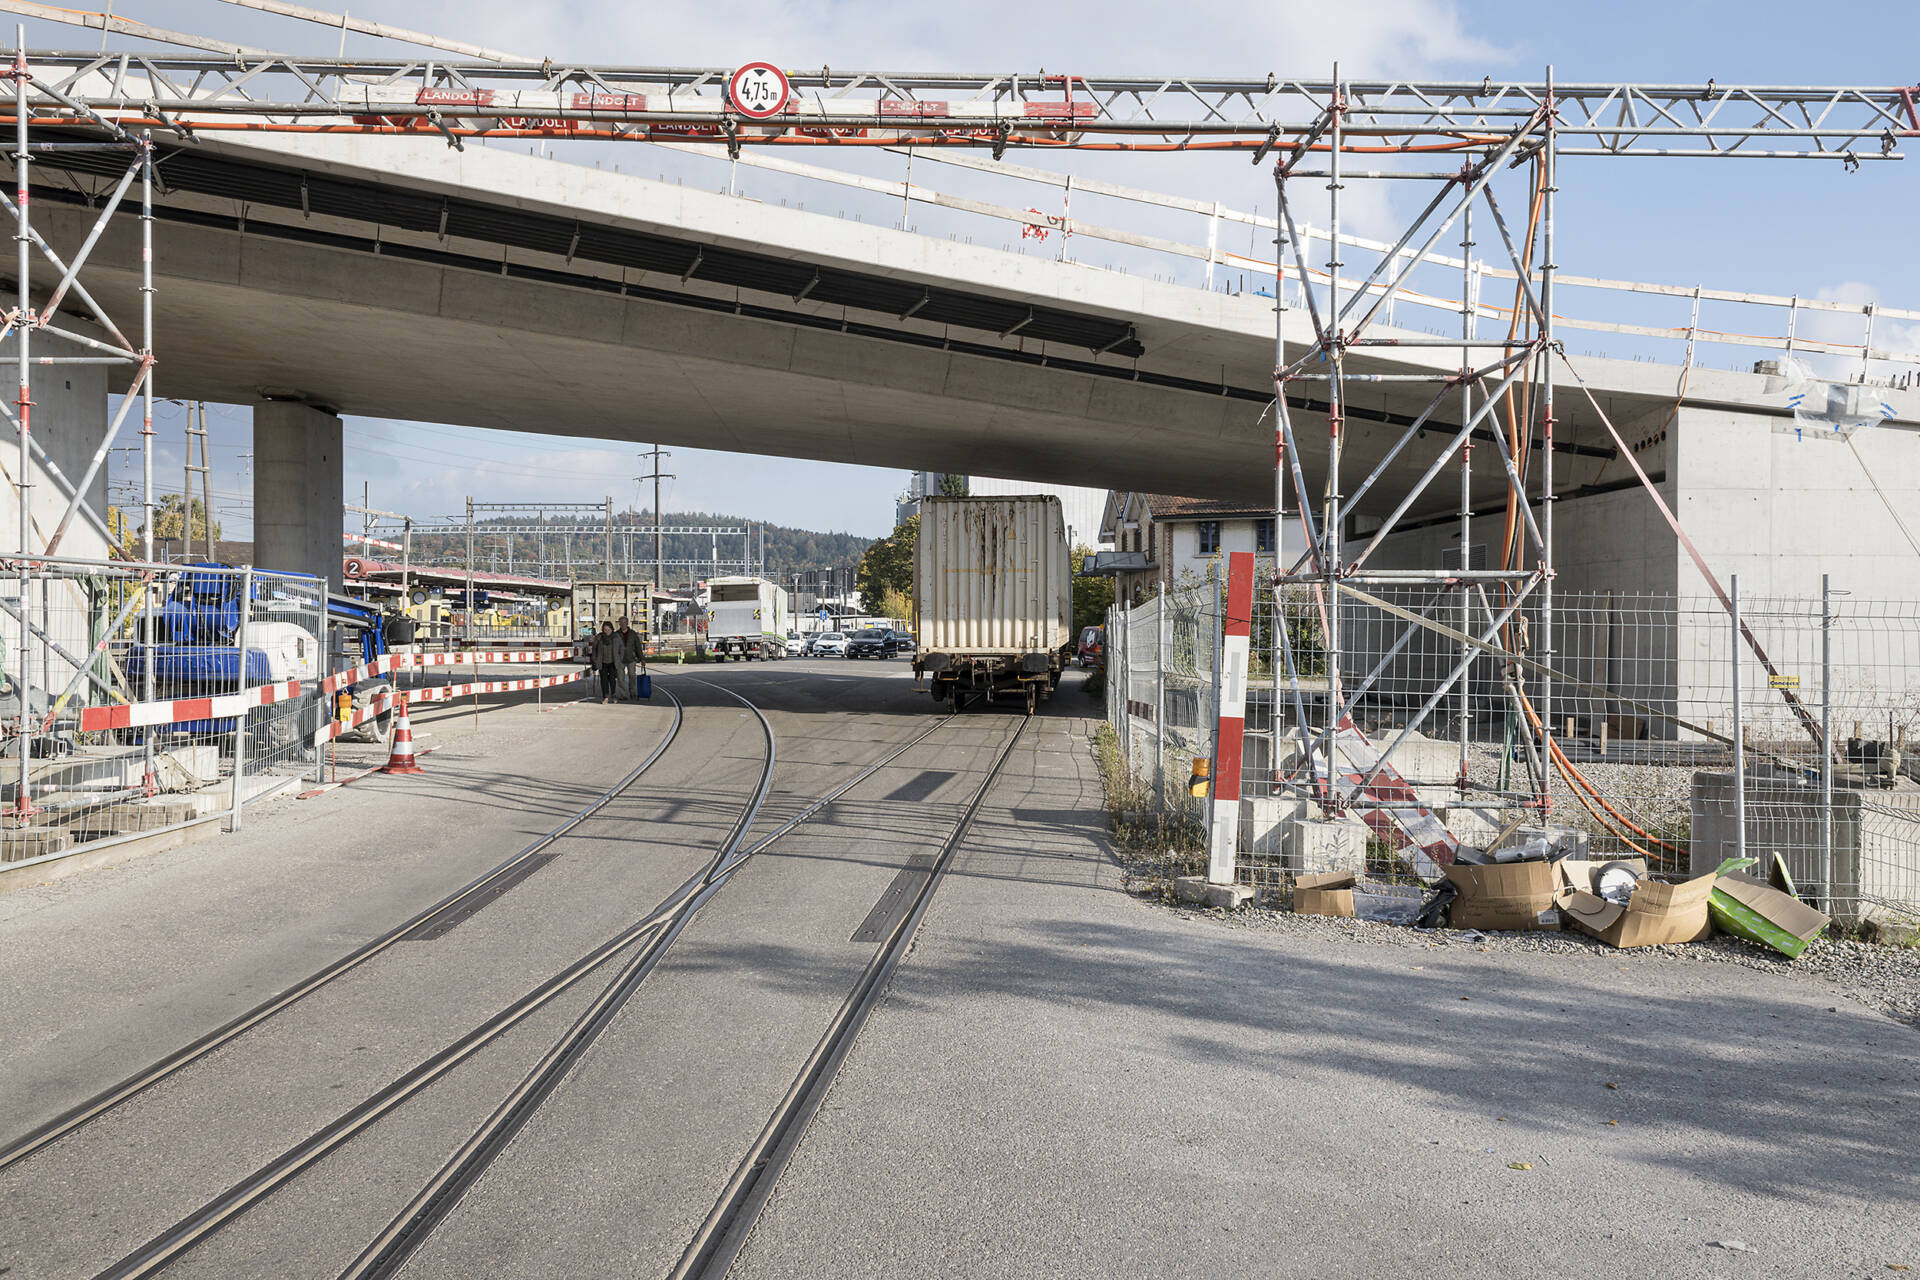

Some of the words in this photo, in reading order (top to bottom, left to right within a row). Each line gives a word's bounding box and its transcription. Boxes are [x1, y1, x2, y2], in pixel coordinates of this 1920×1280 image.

[741, 77, 769, 102] 4,75
[770, 91, 778, 101] m
[423, 91, 485, 101] LANDOLT
[578, 95, 640, 106] LANDOLT
[511, 117, 567, 128] LADOLT
[349, 561, 359, 575] 2
